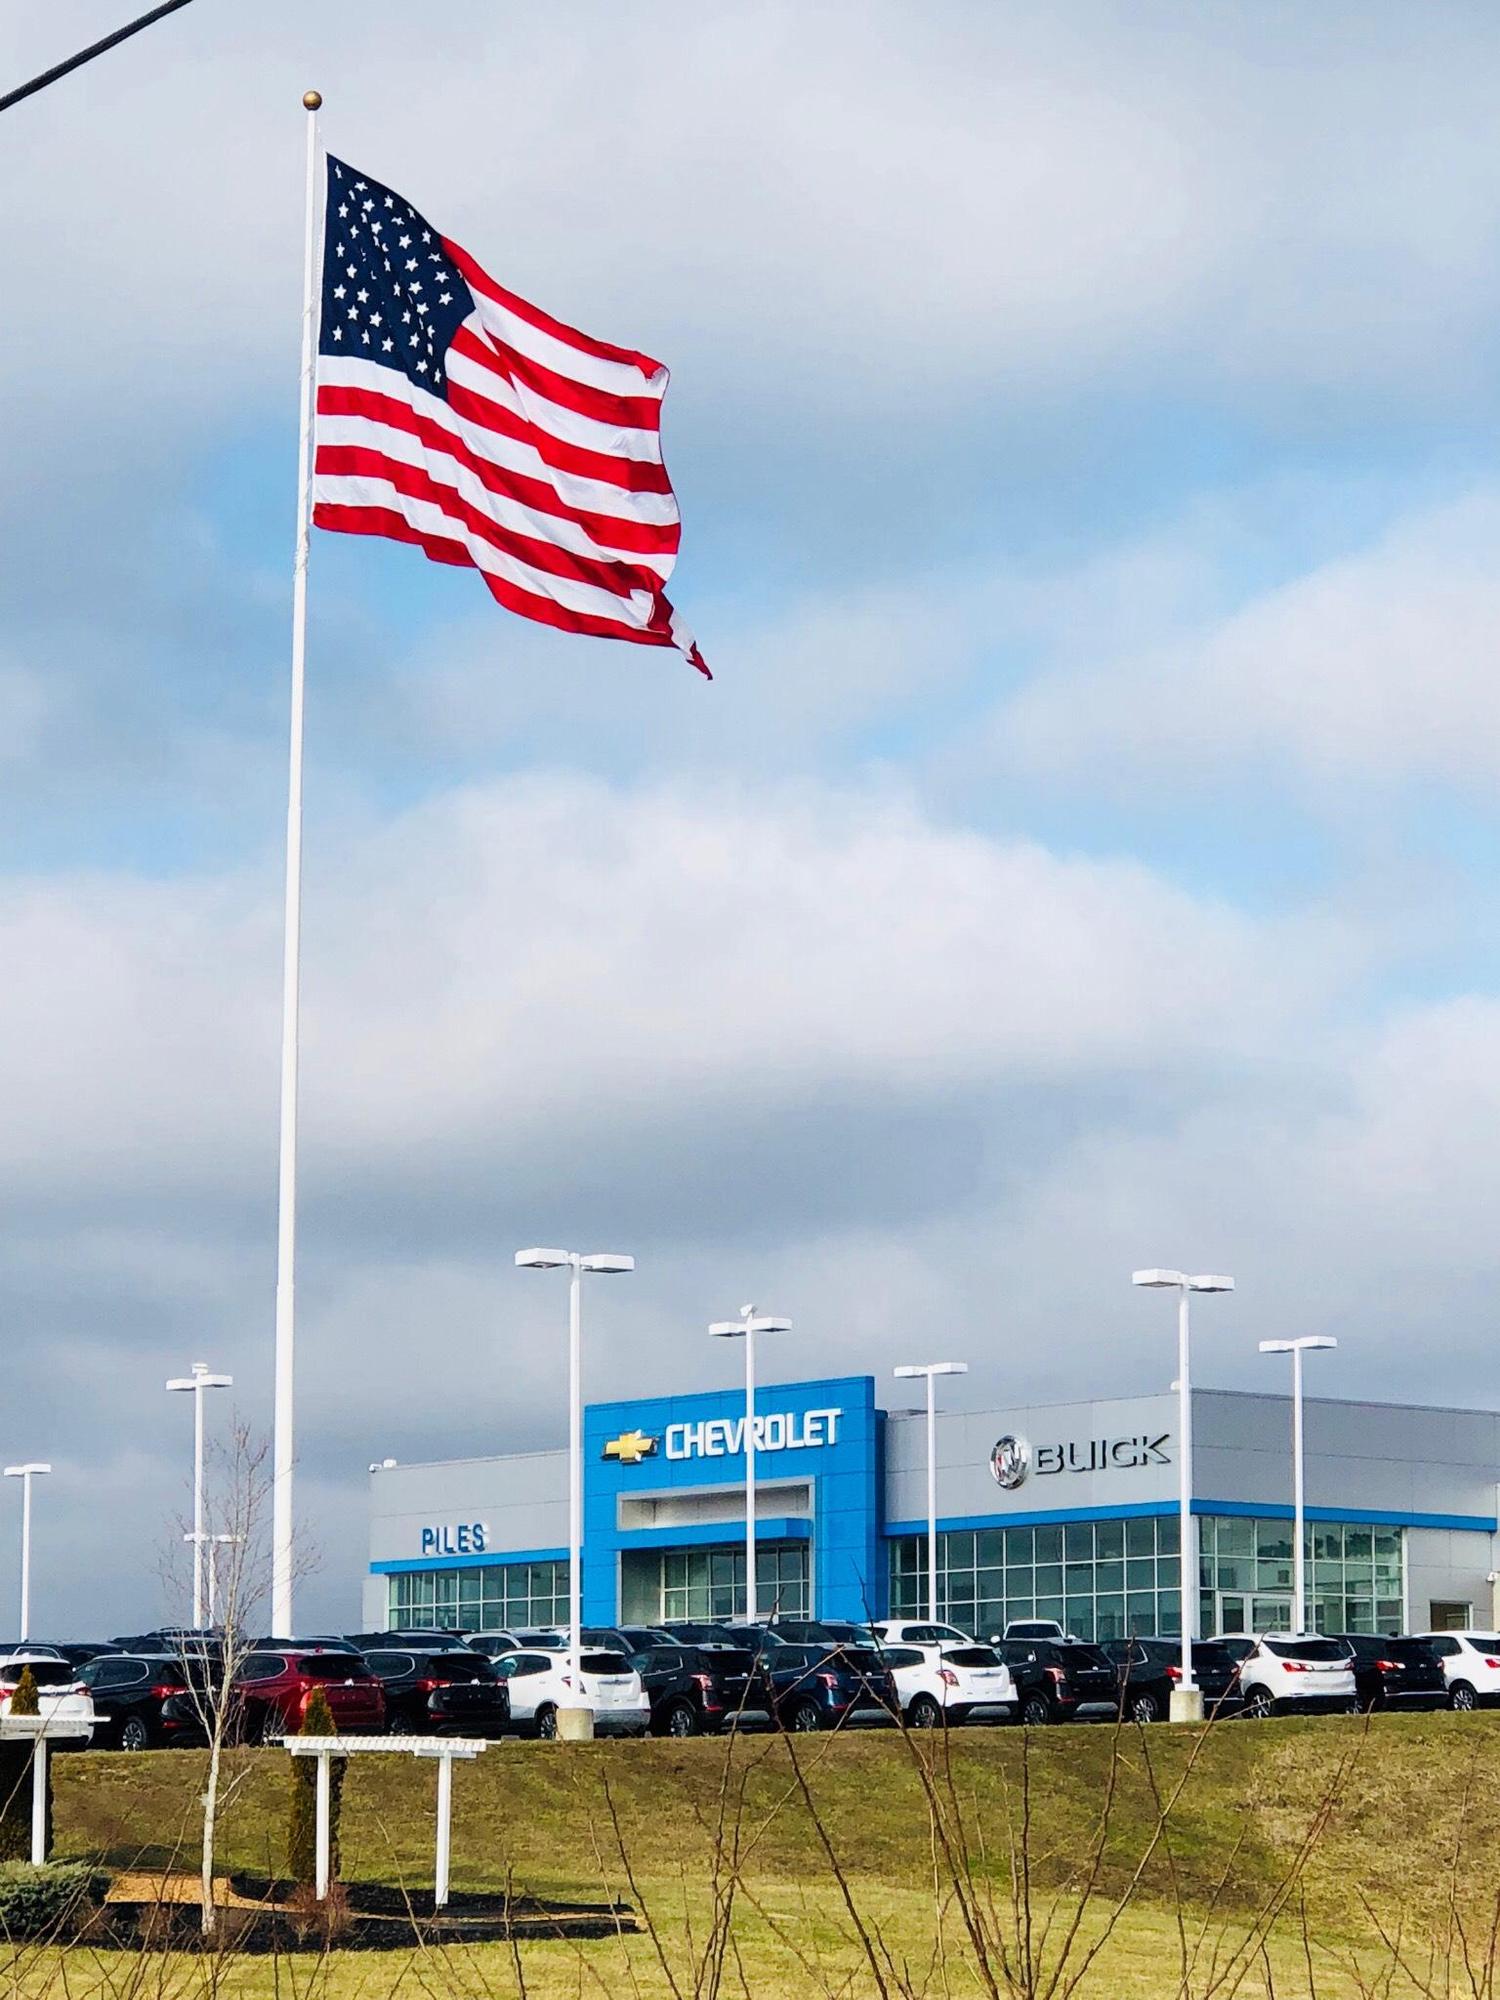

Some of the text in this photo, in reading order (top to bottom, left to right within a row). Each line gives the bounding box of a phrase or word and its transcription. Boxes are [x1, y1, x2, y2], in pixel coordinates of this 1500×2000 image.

[665, 1408, 842, 1460] CHEVROLET
[1034, 1433, 1171, 1475] BUICK
[421, 1523, 486, 1555] PILES
